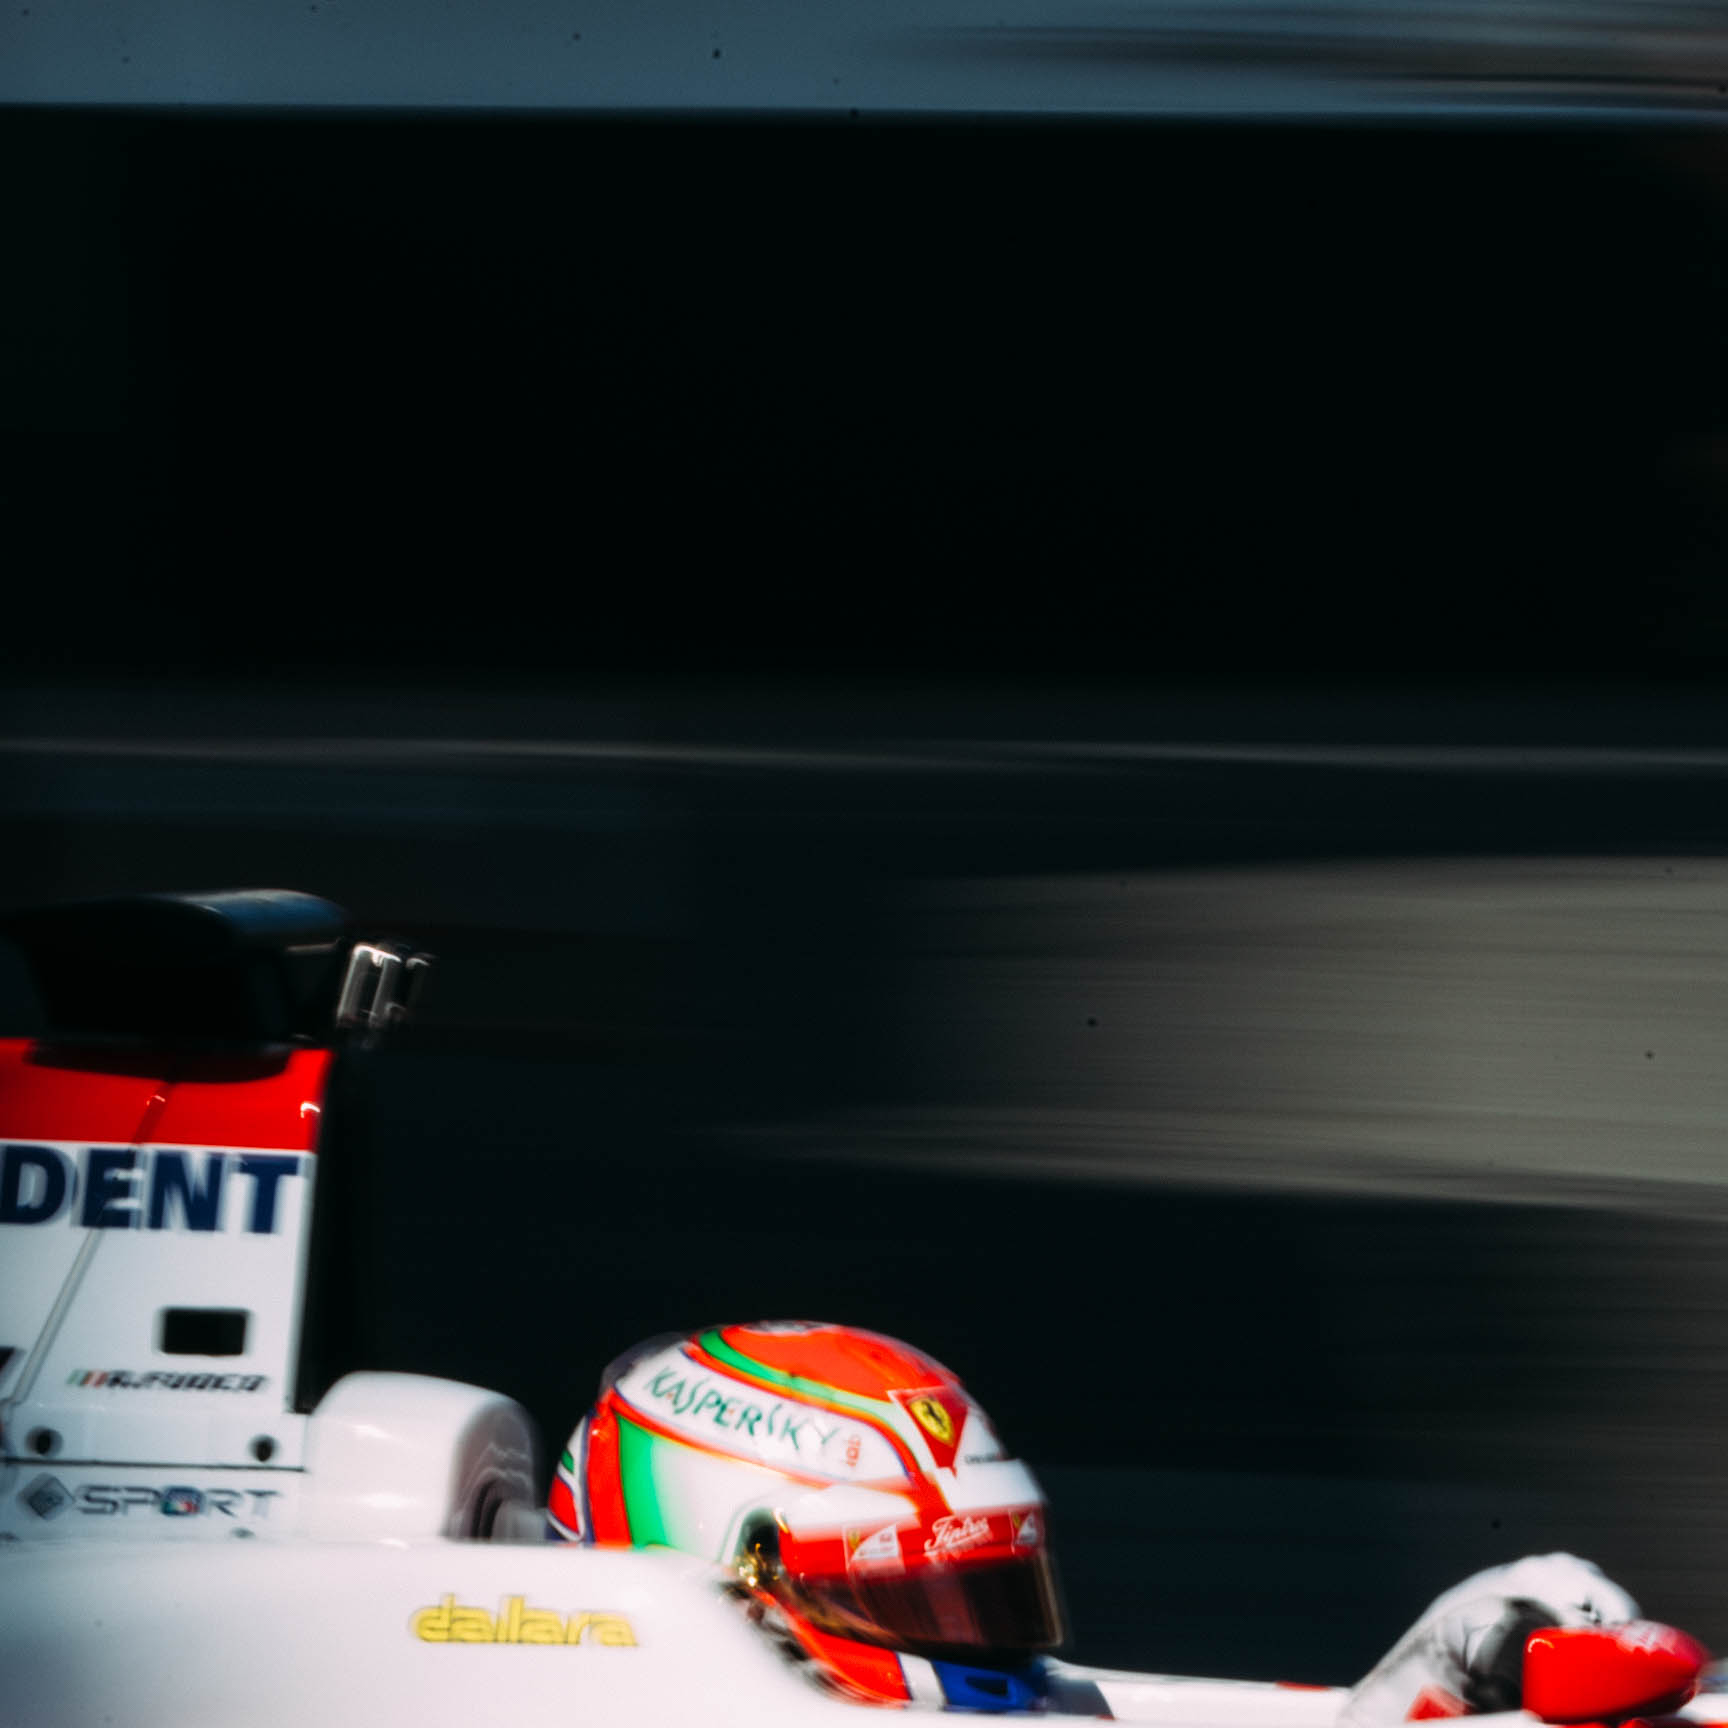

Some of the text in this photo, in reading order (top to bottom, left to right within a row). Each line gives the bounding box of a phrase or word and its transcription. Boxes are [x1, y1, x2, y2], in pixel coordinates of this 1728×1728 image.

[645, 1366, 841, 1452] KASPERSKY
[75, 1485, 281, 1517] SPORT
[409, 1592, 640, 1648] dallara
